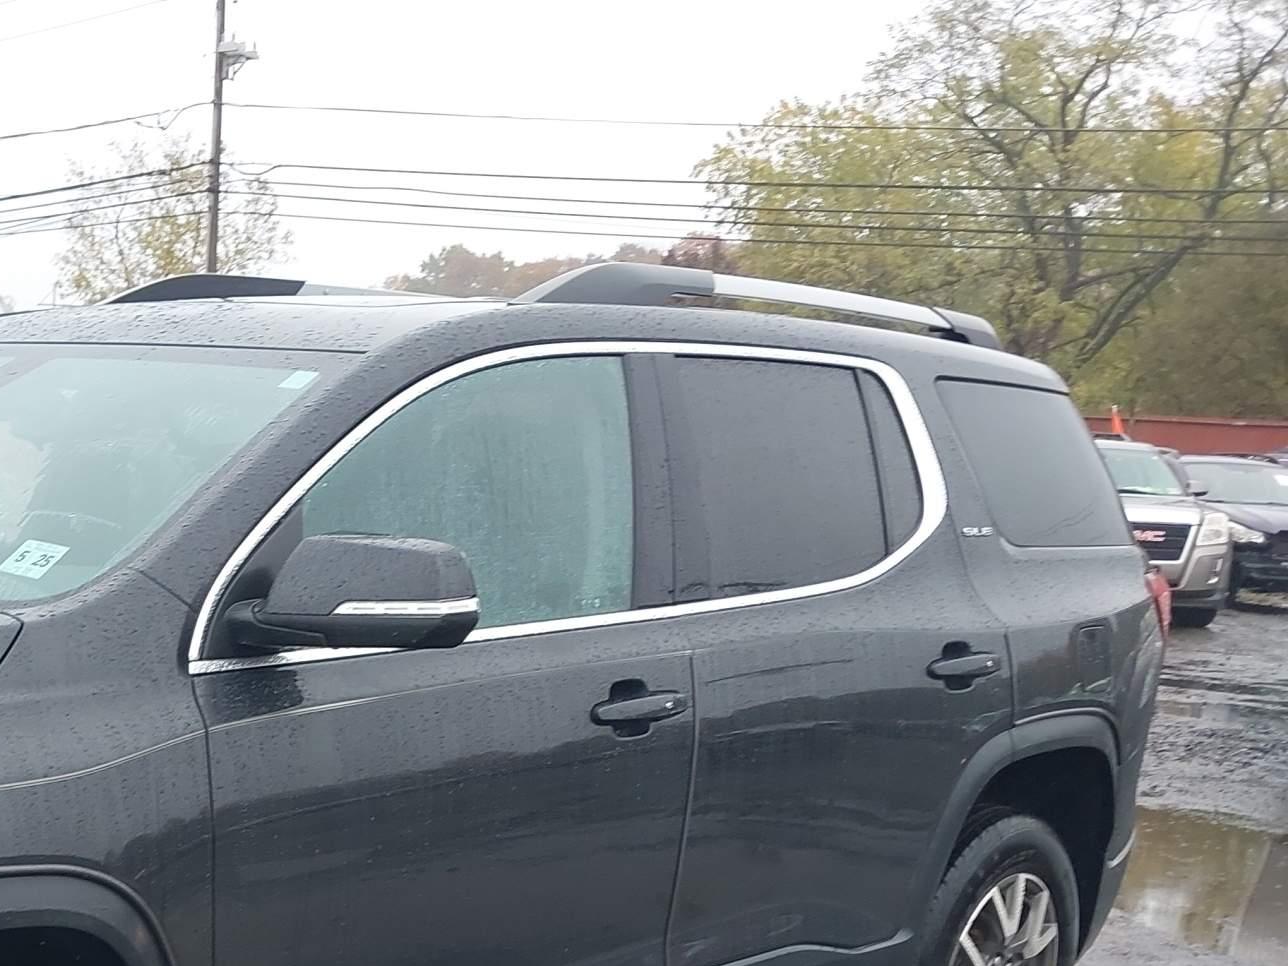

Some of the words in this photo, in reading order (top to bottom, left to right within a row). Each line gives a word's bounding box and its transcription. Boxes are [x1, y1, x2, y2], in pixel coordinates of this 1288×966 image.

[1132, 529, 1166, 542] MC
[15, 550, 31, 562] 5
[31, 553, 55, 568] 25
